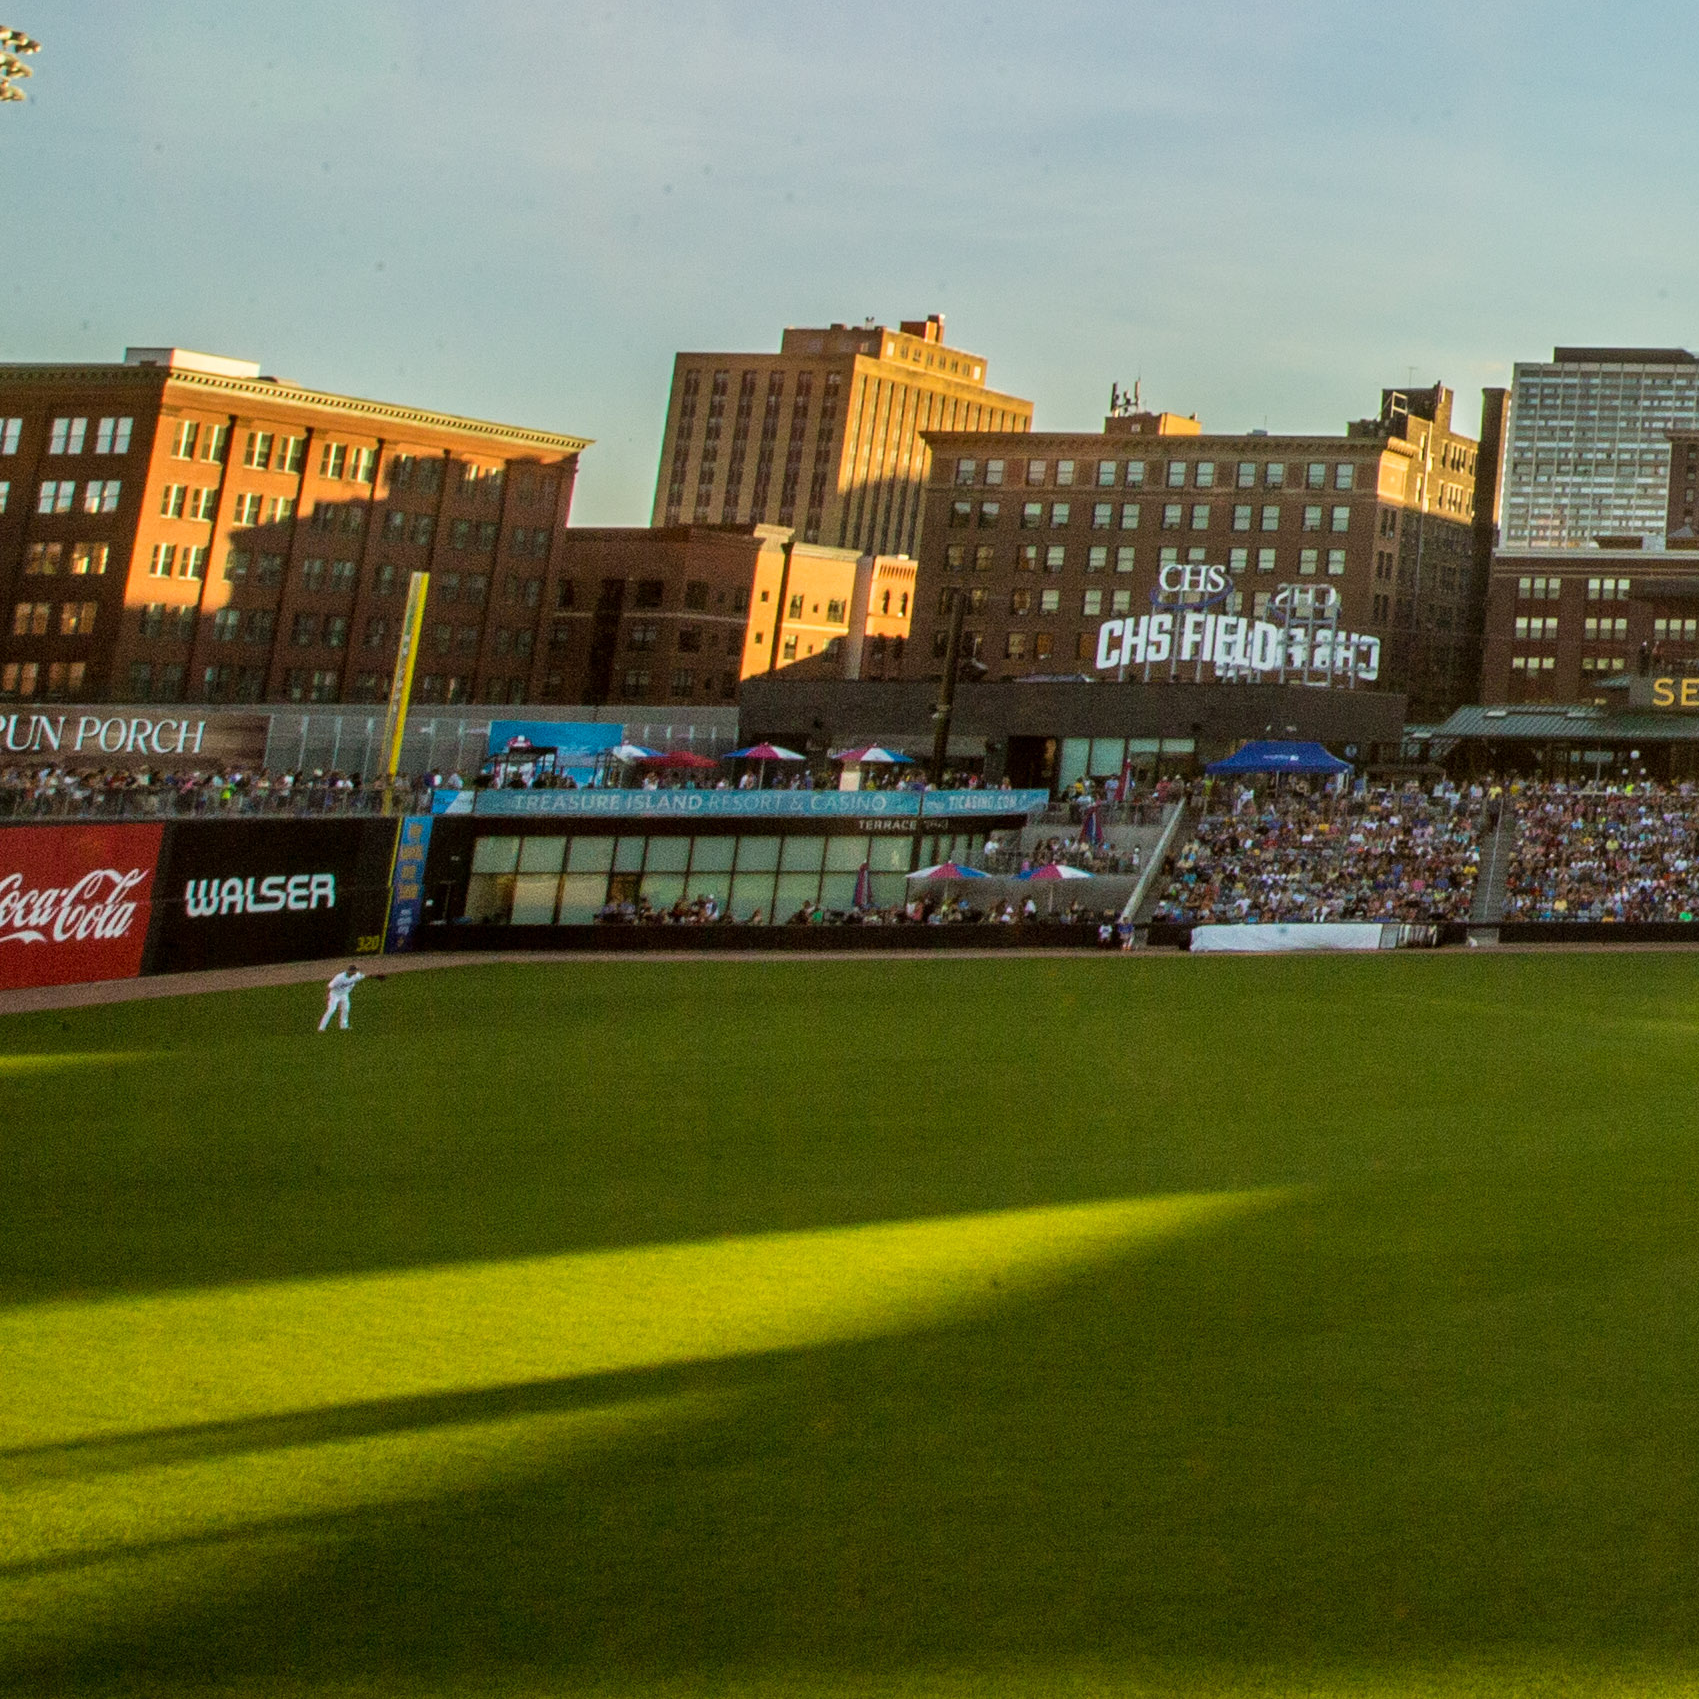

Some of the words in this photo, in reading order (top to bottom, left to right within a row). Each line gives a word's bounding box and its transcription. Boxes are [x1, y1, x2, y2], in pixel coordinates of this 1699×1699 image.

[1159, 564, 1226, 592] CHS
[1096, 614, 1173, 669] CHS
[1181, 612, 1278, 671] FIELD
[74, 716, 206, 754] PORCH
[515, 794, 620, 811] TREASURE
[626, 794, 701, 811] ISLAND
[707, 794, 783, 811] RESORT
[810, 793, 887, 812] CASINO
[185, 873, 336, 918] WALSER
[356, 935, 380, 952] 320
